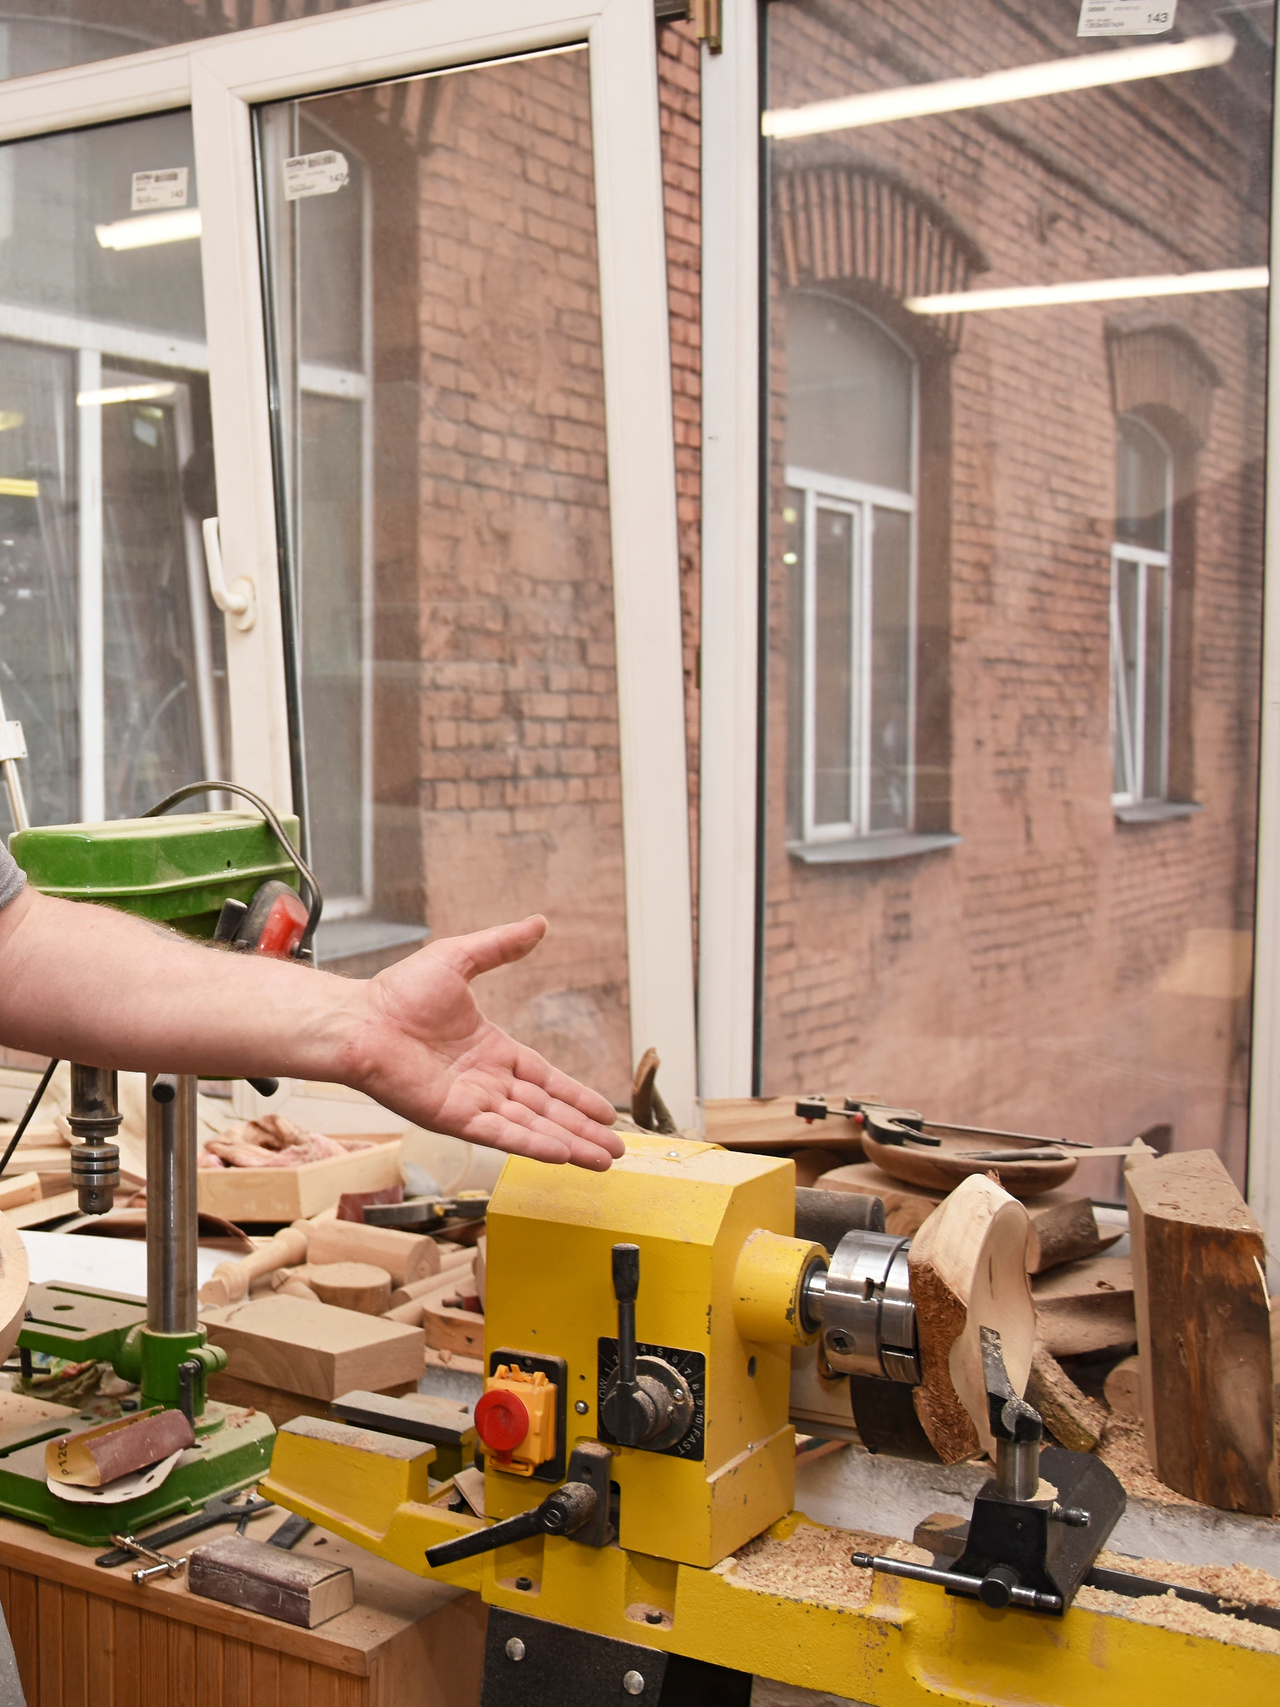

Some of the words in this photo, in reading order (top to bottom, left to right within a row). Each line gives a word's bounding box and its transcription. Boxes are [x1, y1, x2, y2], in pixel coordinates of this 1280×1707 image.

[1146, 12, 1168, 23] 143
[330, 172, 346, 183] 143
[640, 1344, 647, 1353] 4
[656, 1347, 664, 1356] 5
[672, 1354, 680, 1363] 6
[683, 1367, 692, 1375] 7
